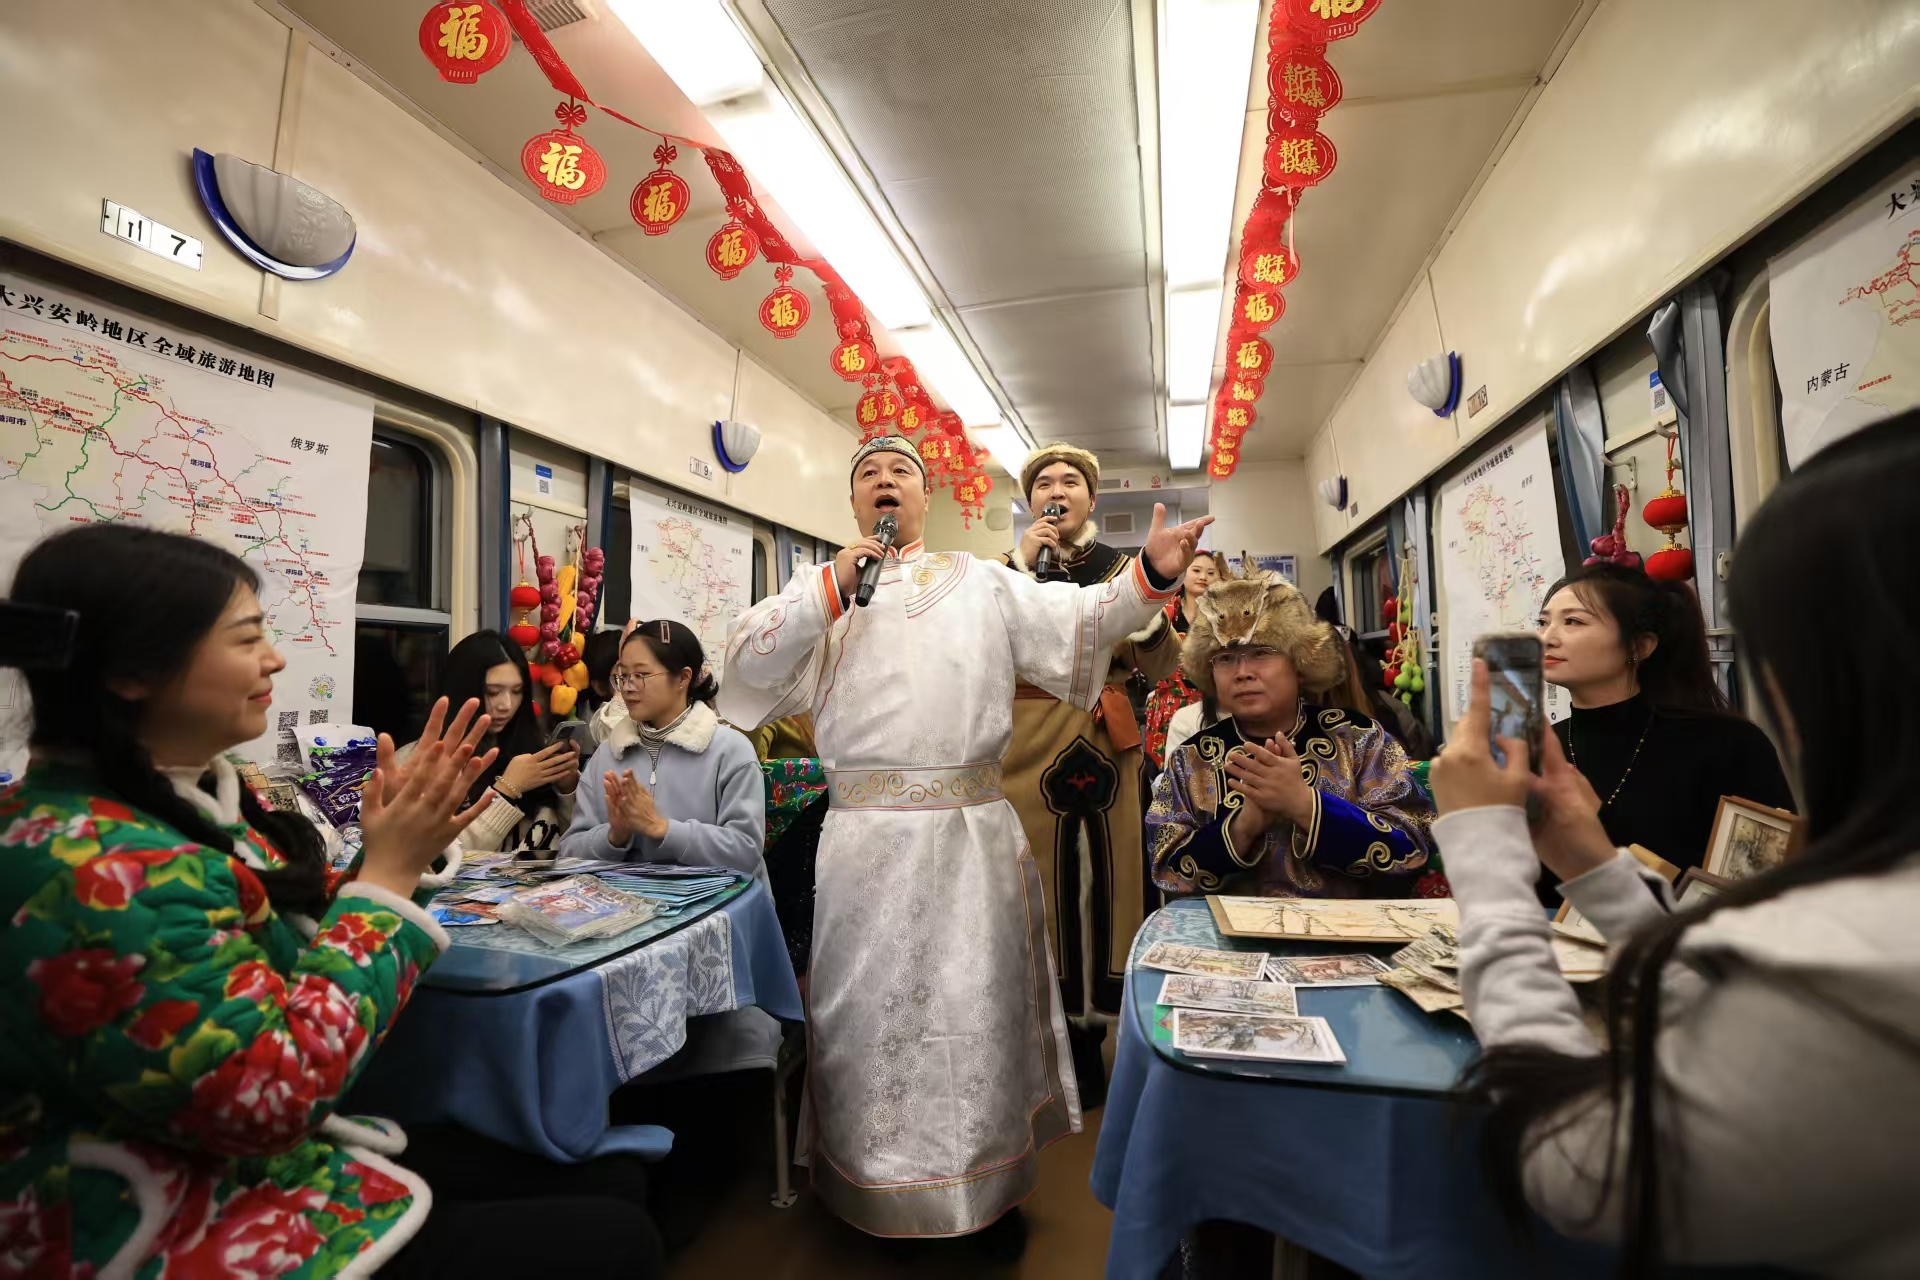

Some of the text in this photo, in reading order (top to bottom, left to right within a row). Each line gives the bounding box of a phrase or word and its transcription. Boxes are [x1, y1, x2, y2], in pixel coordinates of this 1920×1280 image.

[439, 4, 489, 61] 福
[1282, 62, 1323, 90] 新年
[1278, 138, 1318, 160] 新年
[540, 142, 587, 190] 福
[643, 182, 677, 223] 福
[171, 233, 187, 256] 7
[717, 229, 747, 267] 福
[769, 293, 800, 328] 福
[1244, 293, 1275, 323] 福
[840, 344, 866, 373] 福
[1236, 341, 1263, 369] 福
[1807, 362, 1851, 394] 内蒙古
[859, 397, 878, 422] 福
[901, 406, 919, 429] 福
[290, 436, 330, 456] 俄罗斯
[190, 457, 213, 469] 塔河县
[703, 465, 709, 476] 9
[1123, 480, 1130, 488] 4
